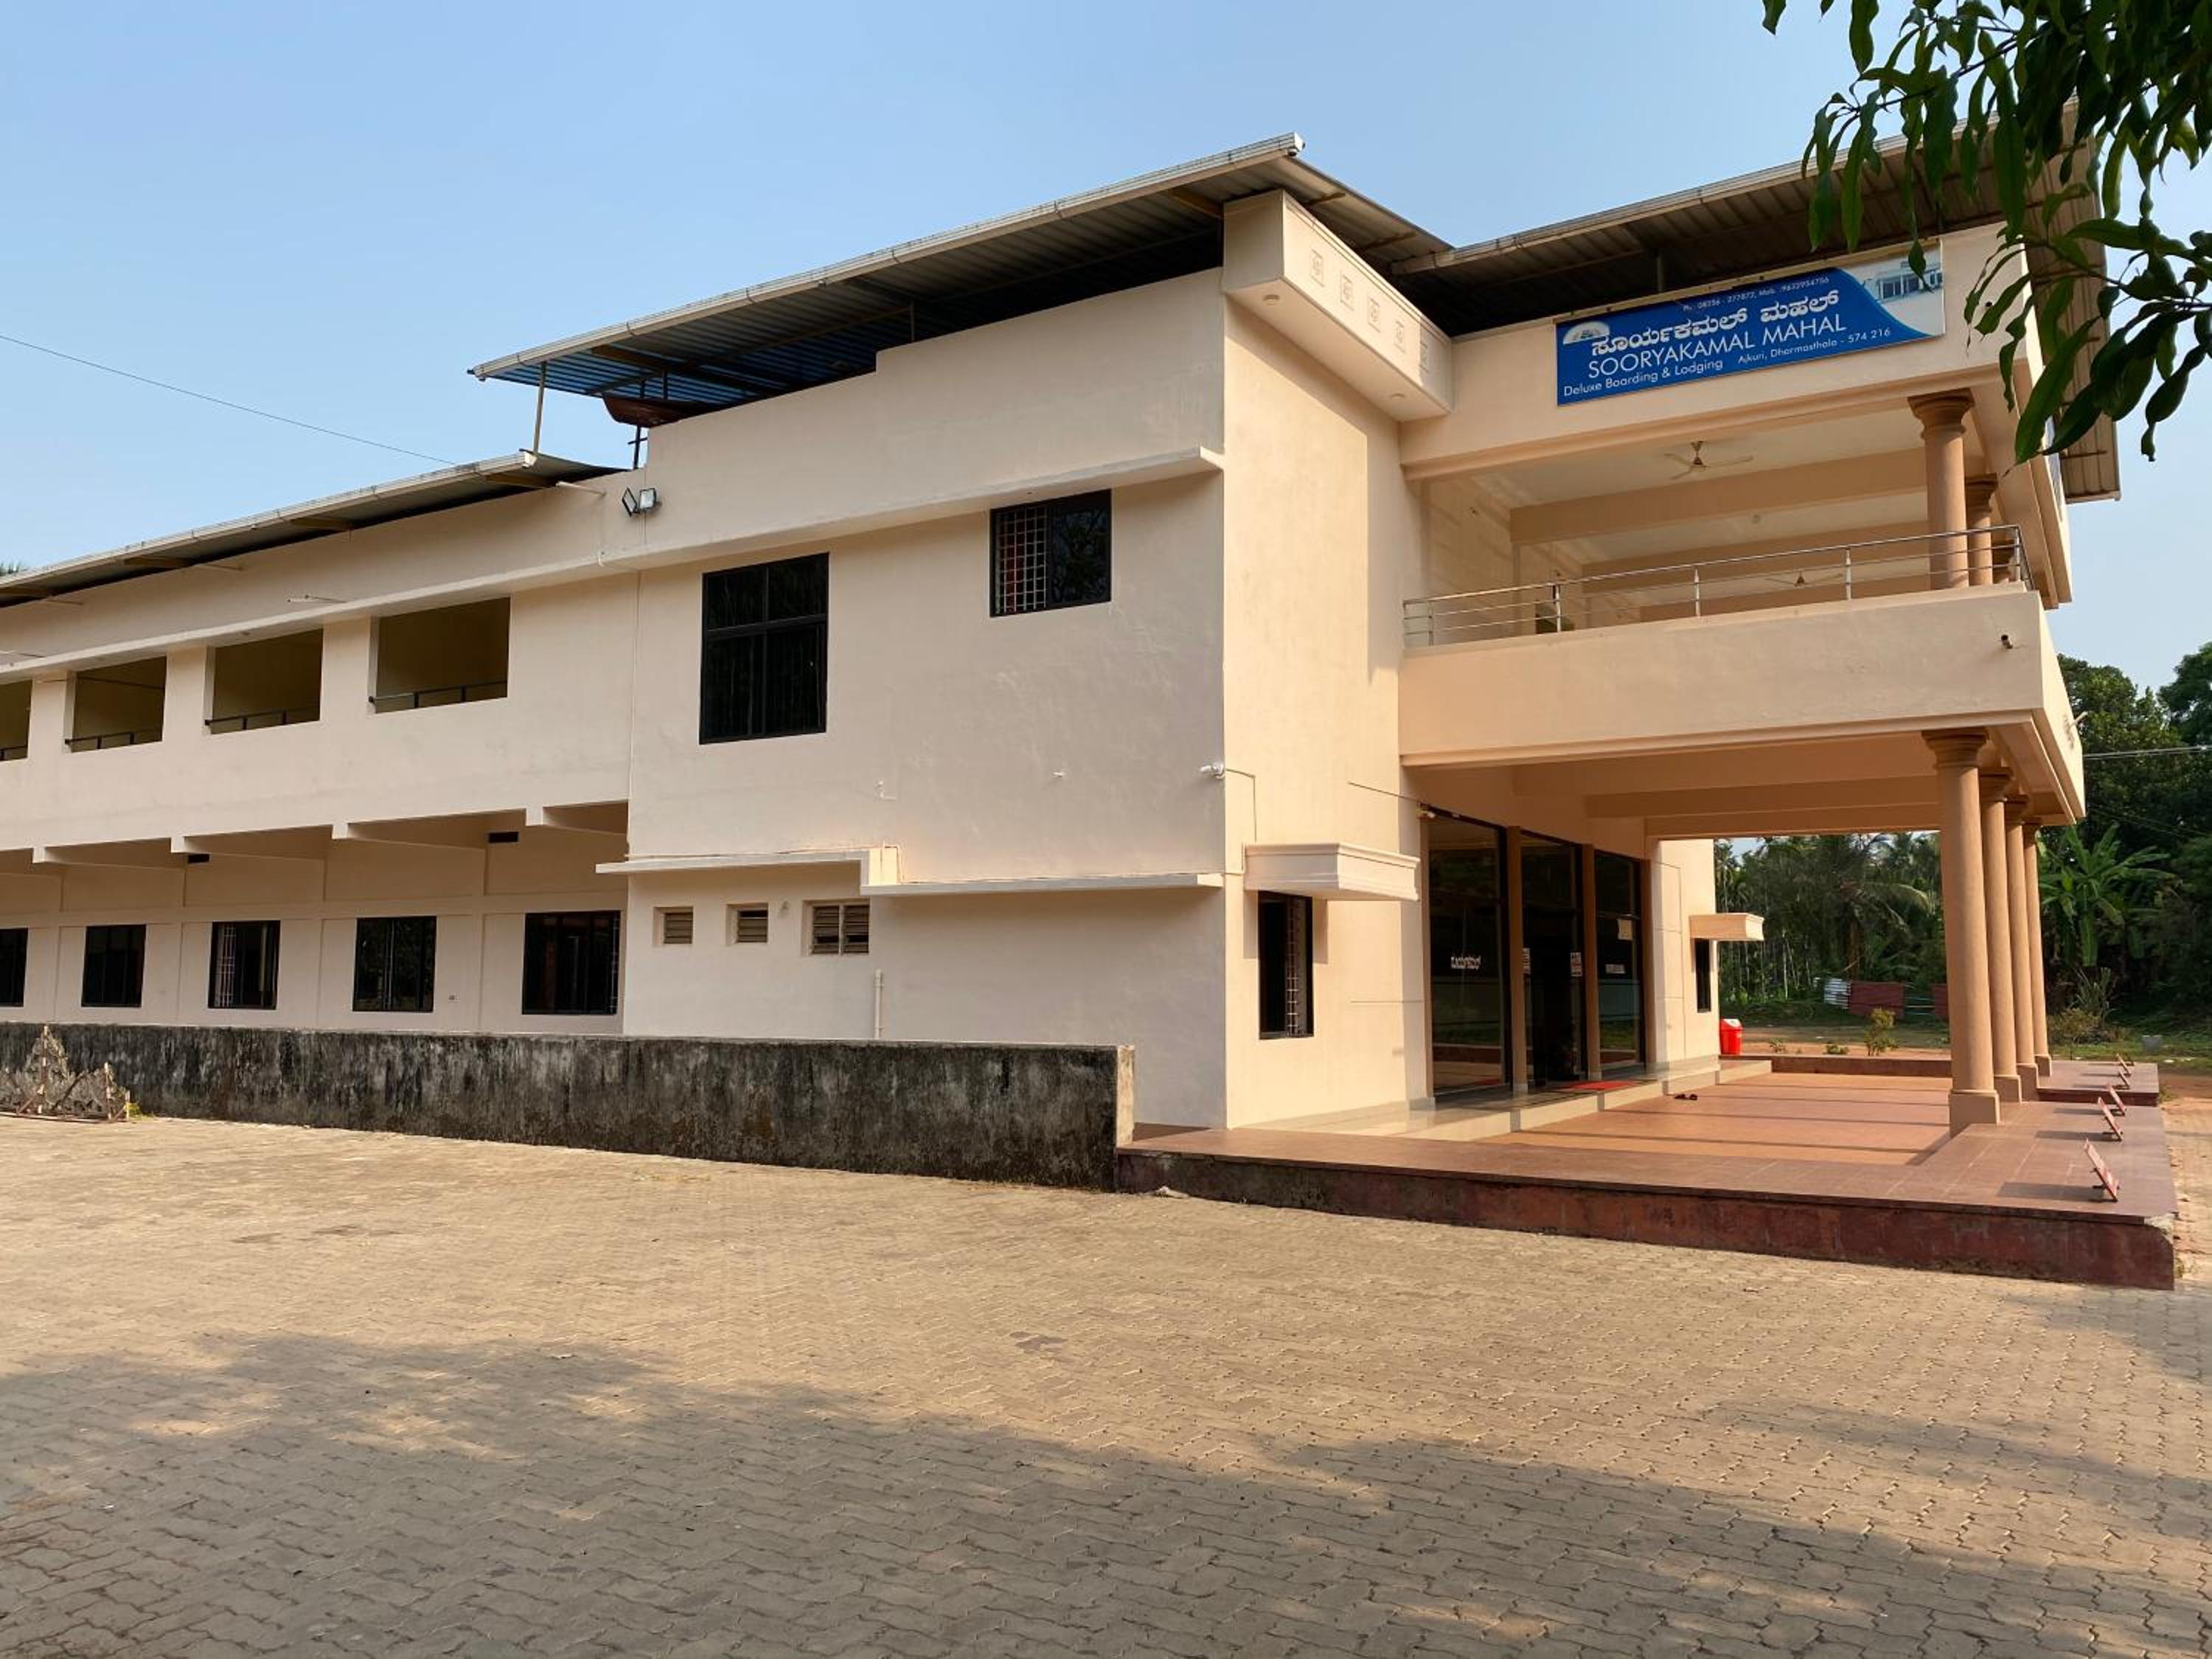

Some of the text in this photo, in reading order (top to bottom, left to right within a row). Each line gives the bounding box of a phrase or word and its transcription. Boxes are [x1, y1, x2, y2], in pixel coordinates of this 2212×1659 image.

[1588, 313, 1847, 378] SOORYAKAMAL MAHAL
[1592, 290, 1840, 356] ಸೂರ್ಯಕಮಲ್ ಮಹಲ್
[1770, 338, 1837, 358] Dharmasthala
[1848, 333, 1868, 343] 574
[1871, 327, 1891, 339] 216
[1564, 359, 1723, 397] Deluxe Boarding & Lodging
